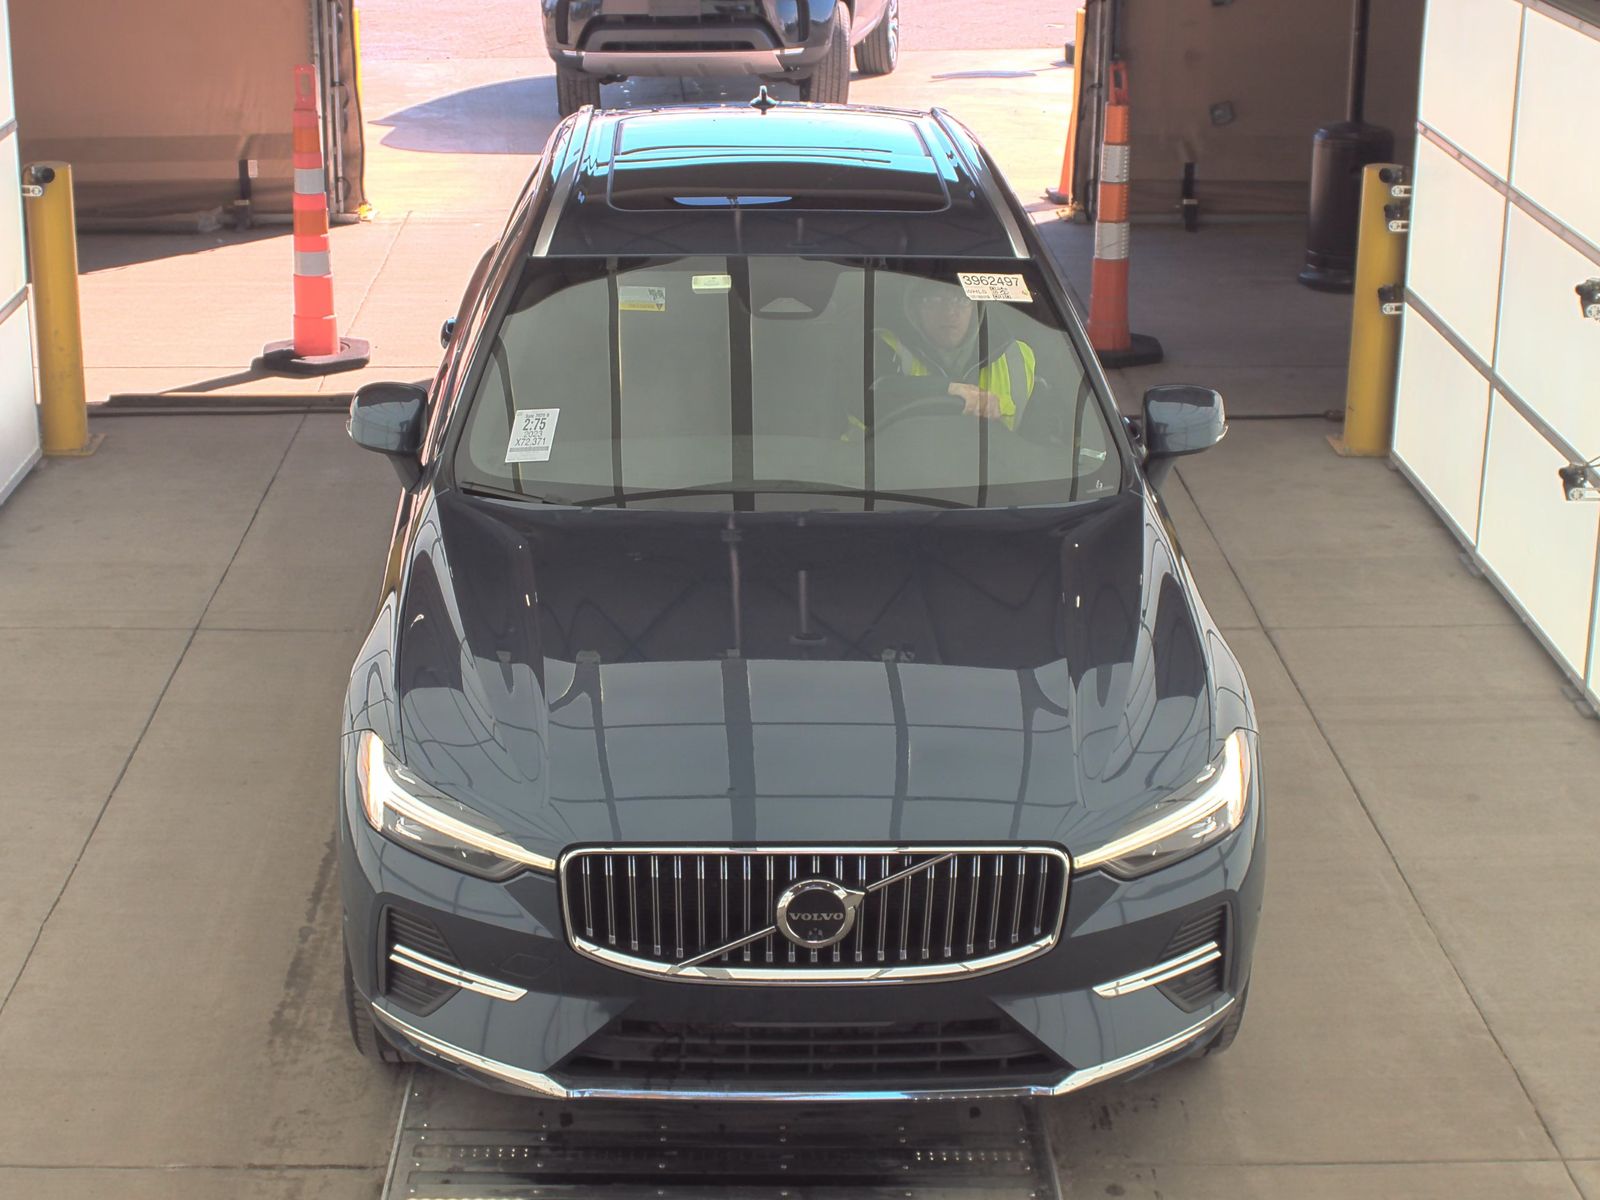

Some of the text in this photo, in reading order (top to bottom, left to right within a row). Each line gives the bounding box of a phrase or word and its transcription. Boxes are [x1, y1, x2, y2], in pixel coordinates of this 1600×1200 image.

[962, 275, 1019, 287] 3962497
[523, 430, 544, 438] 2023
[788, 912, 844, 921] VOLVO
